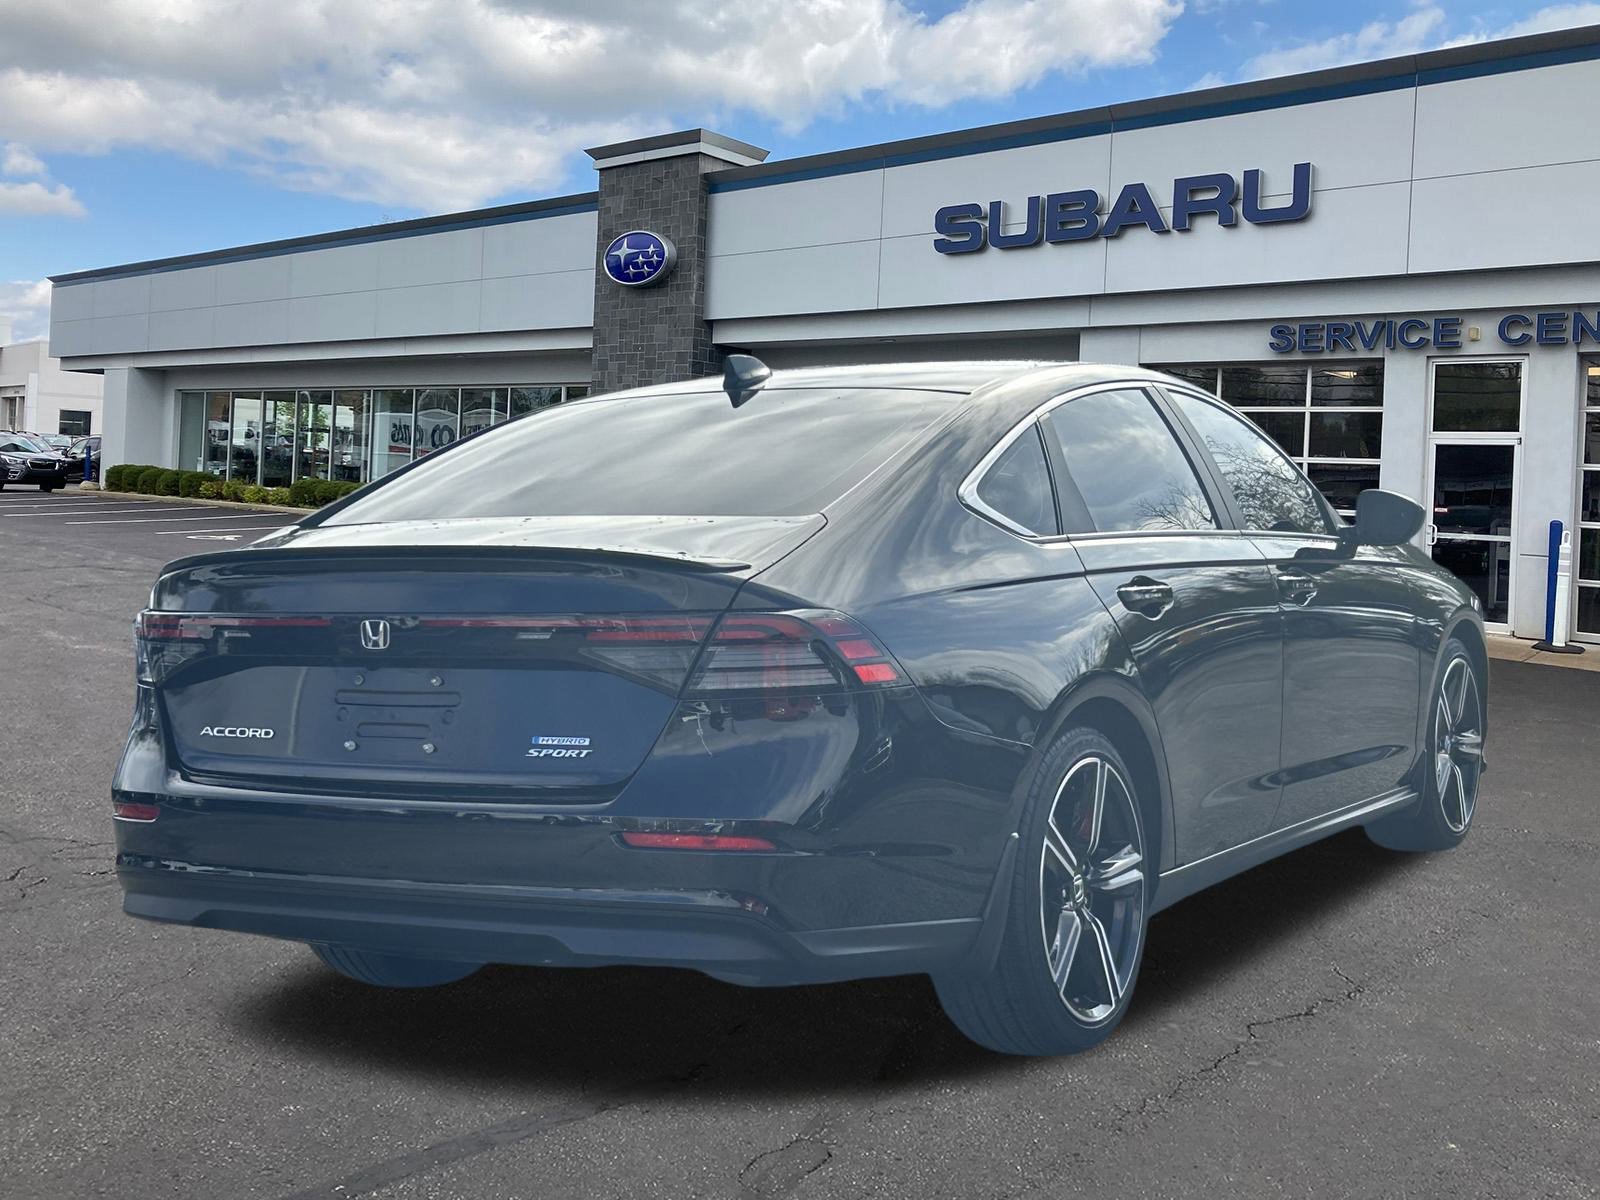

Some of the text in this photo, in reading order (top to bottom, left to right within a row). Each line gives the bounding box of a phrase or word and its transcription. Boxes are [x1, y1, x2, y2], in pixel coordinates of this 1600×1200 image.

[934, 161, 1314, 255] SUBARU
[1269, 317, 1463, 352] SERVICE
[200, 726, 275, 739] ACCORD
[537, 736, 589, 746] HYBRID
[525, 748, 593, 757] SPORT
